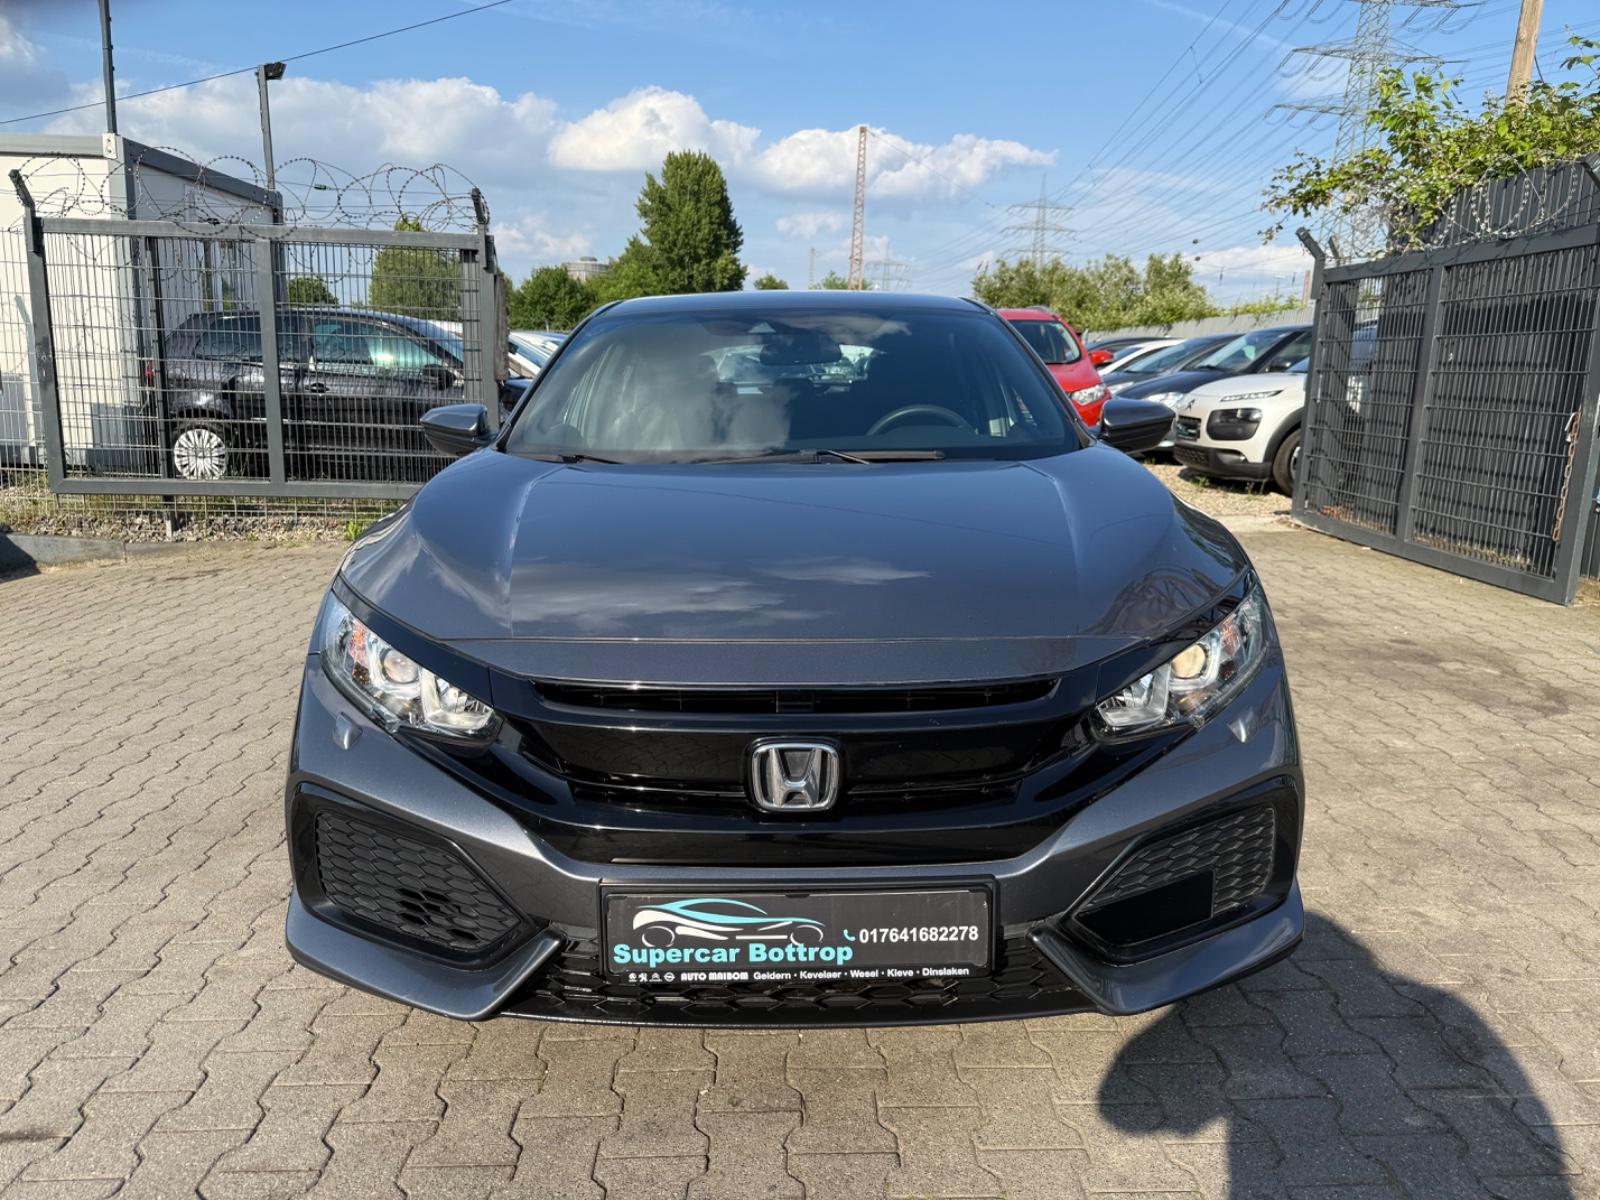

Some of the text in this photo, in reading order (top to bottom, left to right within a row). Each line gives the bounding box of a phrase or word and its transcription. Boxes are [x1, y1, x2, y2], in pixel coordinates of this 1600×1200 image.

[858, 925, 979, 944] 017641682278
[613, 940, 854, 969] Supercar Bottrop
[680, 967, 970, 982] AUTO MAIBOM Geldern Kevelaer Wesel Kleve Dinslaken
